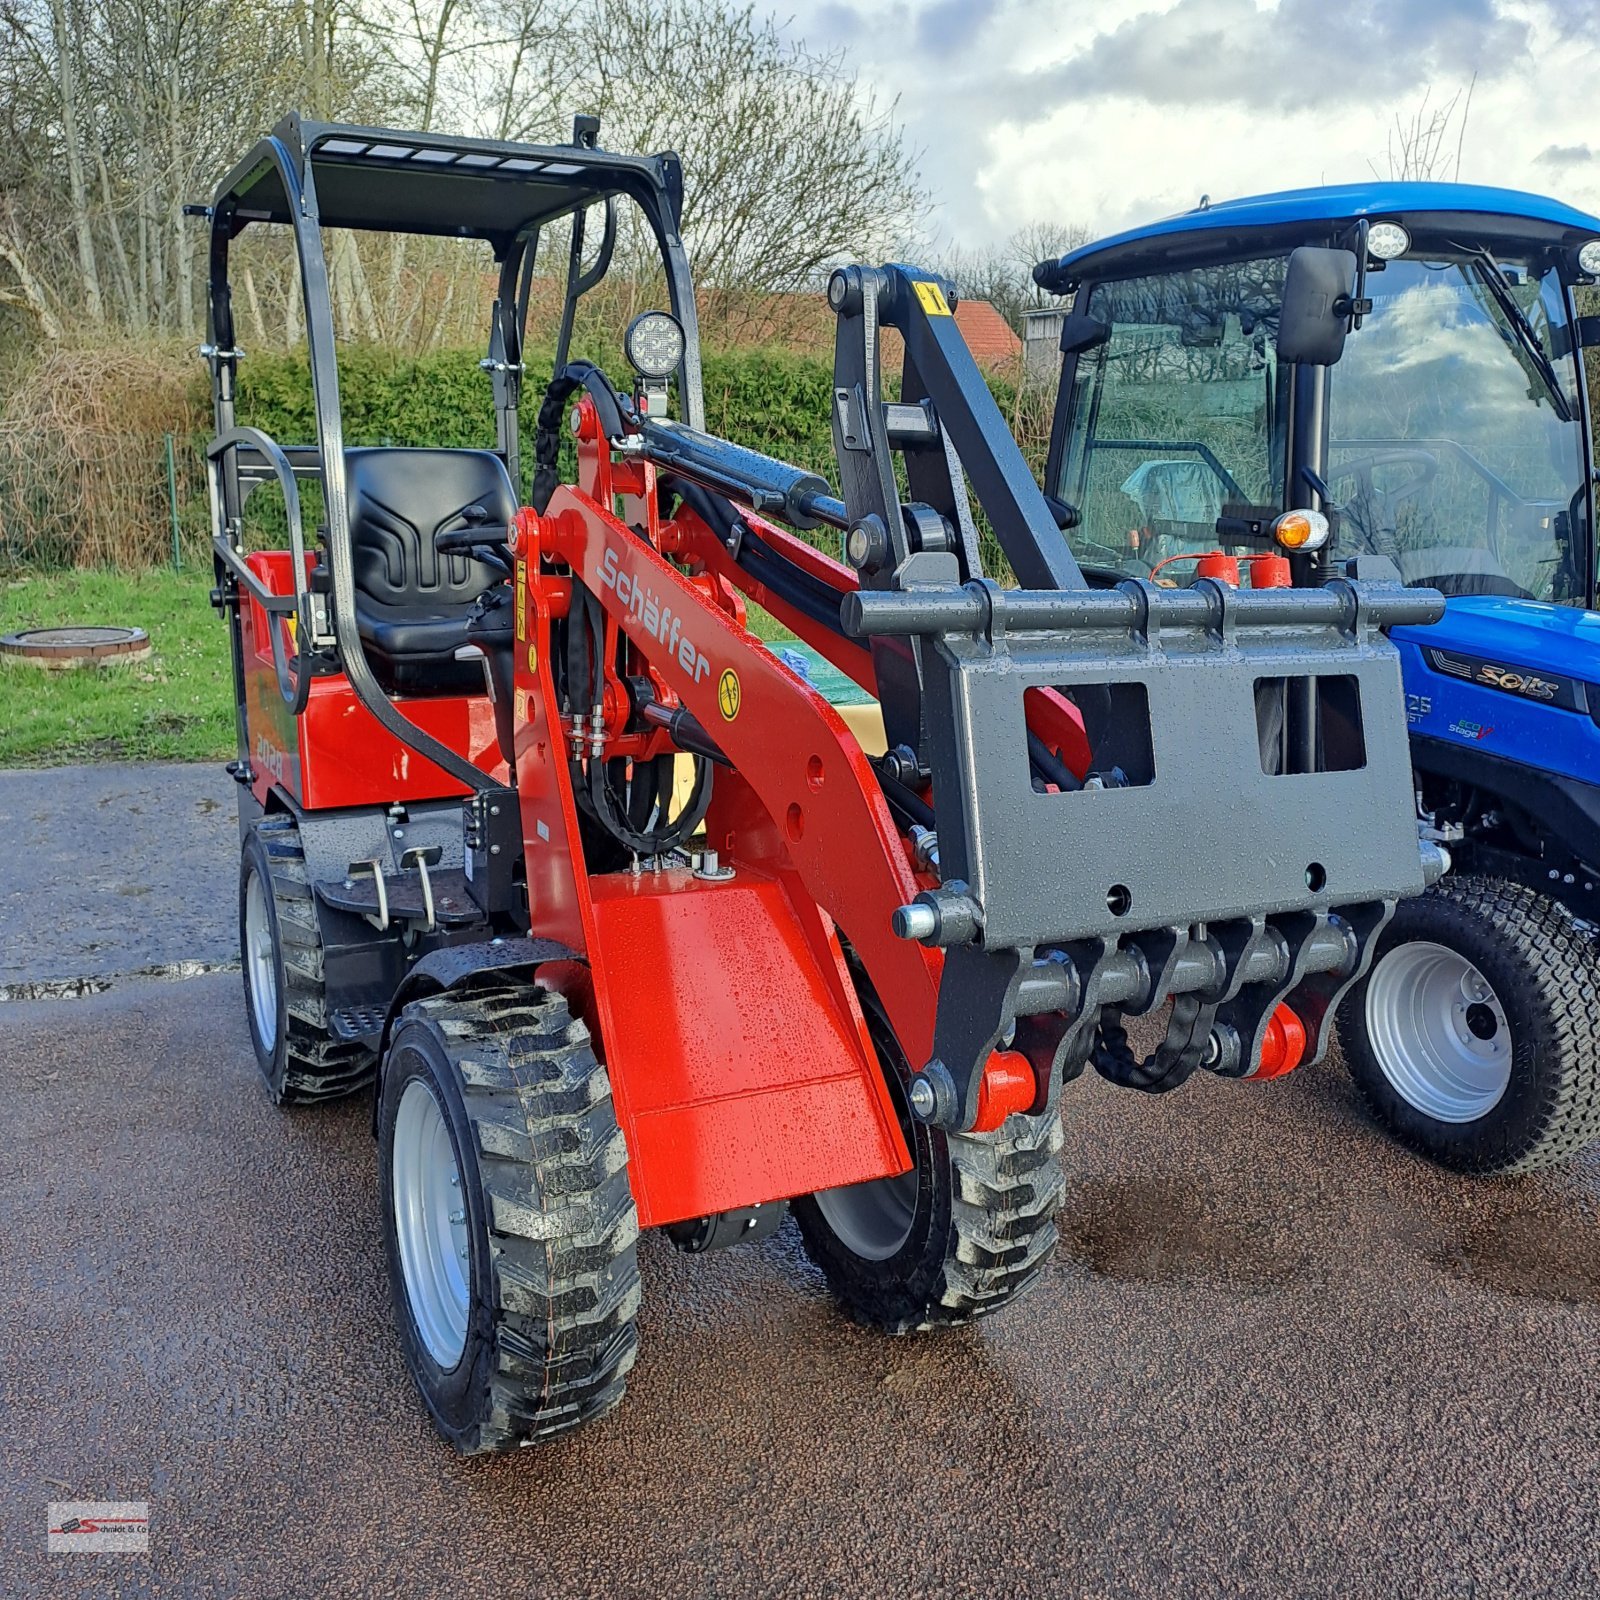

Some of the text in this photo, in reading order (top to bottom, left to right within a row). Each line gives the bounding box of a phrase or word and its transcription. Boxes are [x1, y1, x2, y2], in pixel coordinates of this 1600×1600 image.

[596, 547, 710, 684] Schäffer
[1476, 664, 1559, 699] Solis
[1407, 712, 1424, 724] ST
